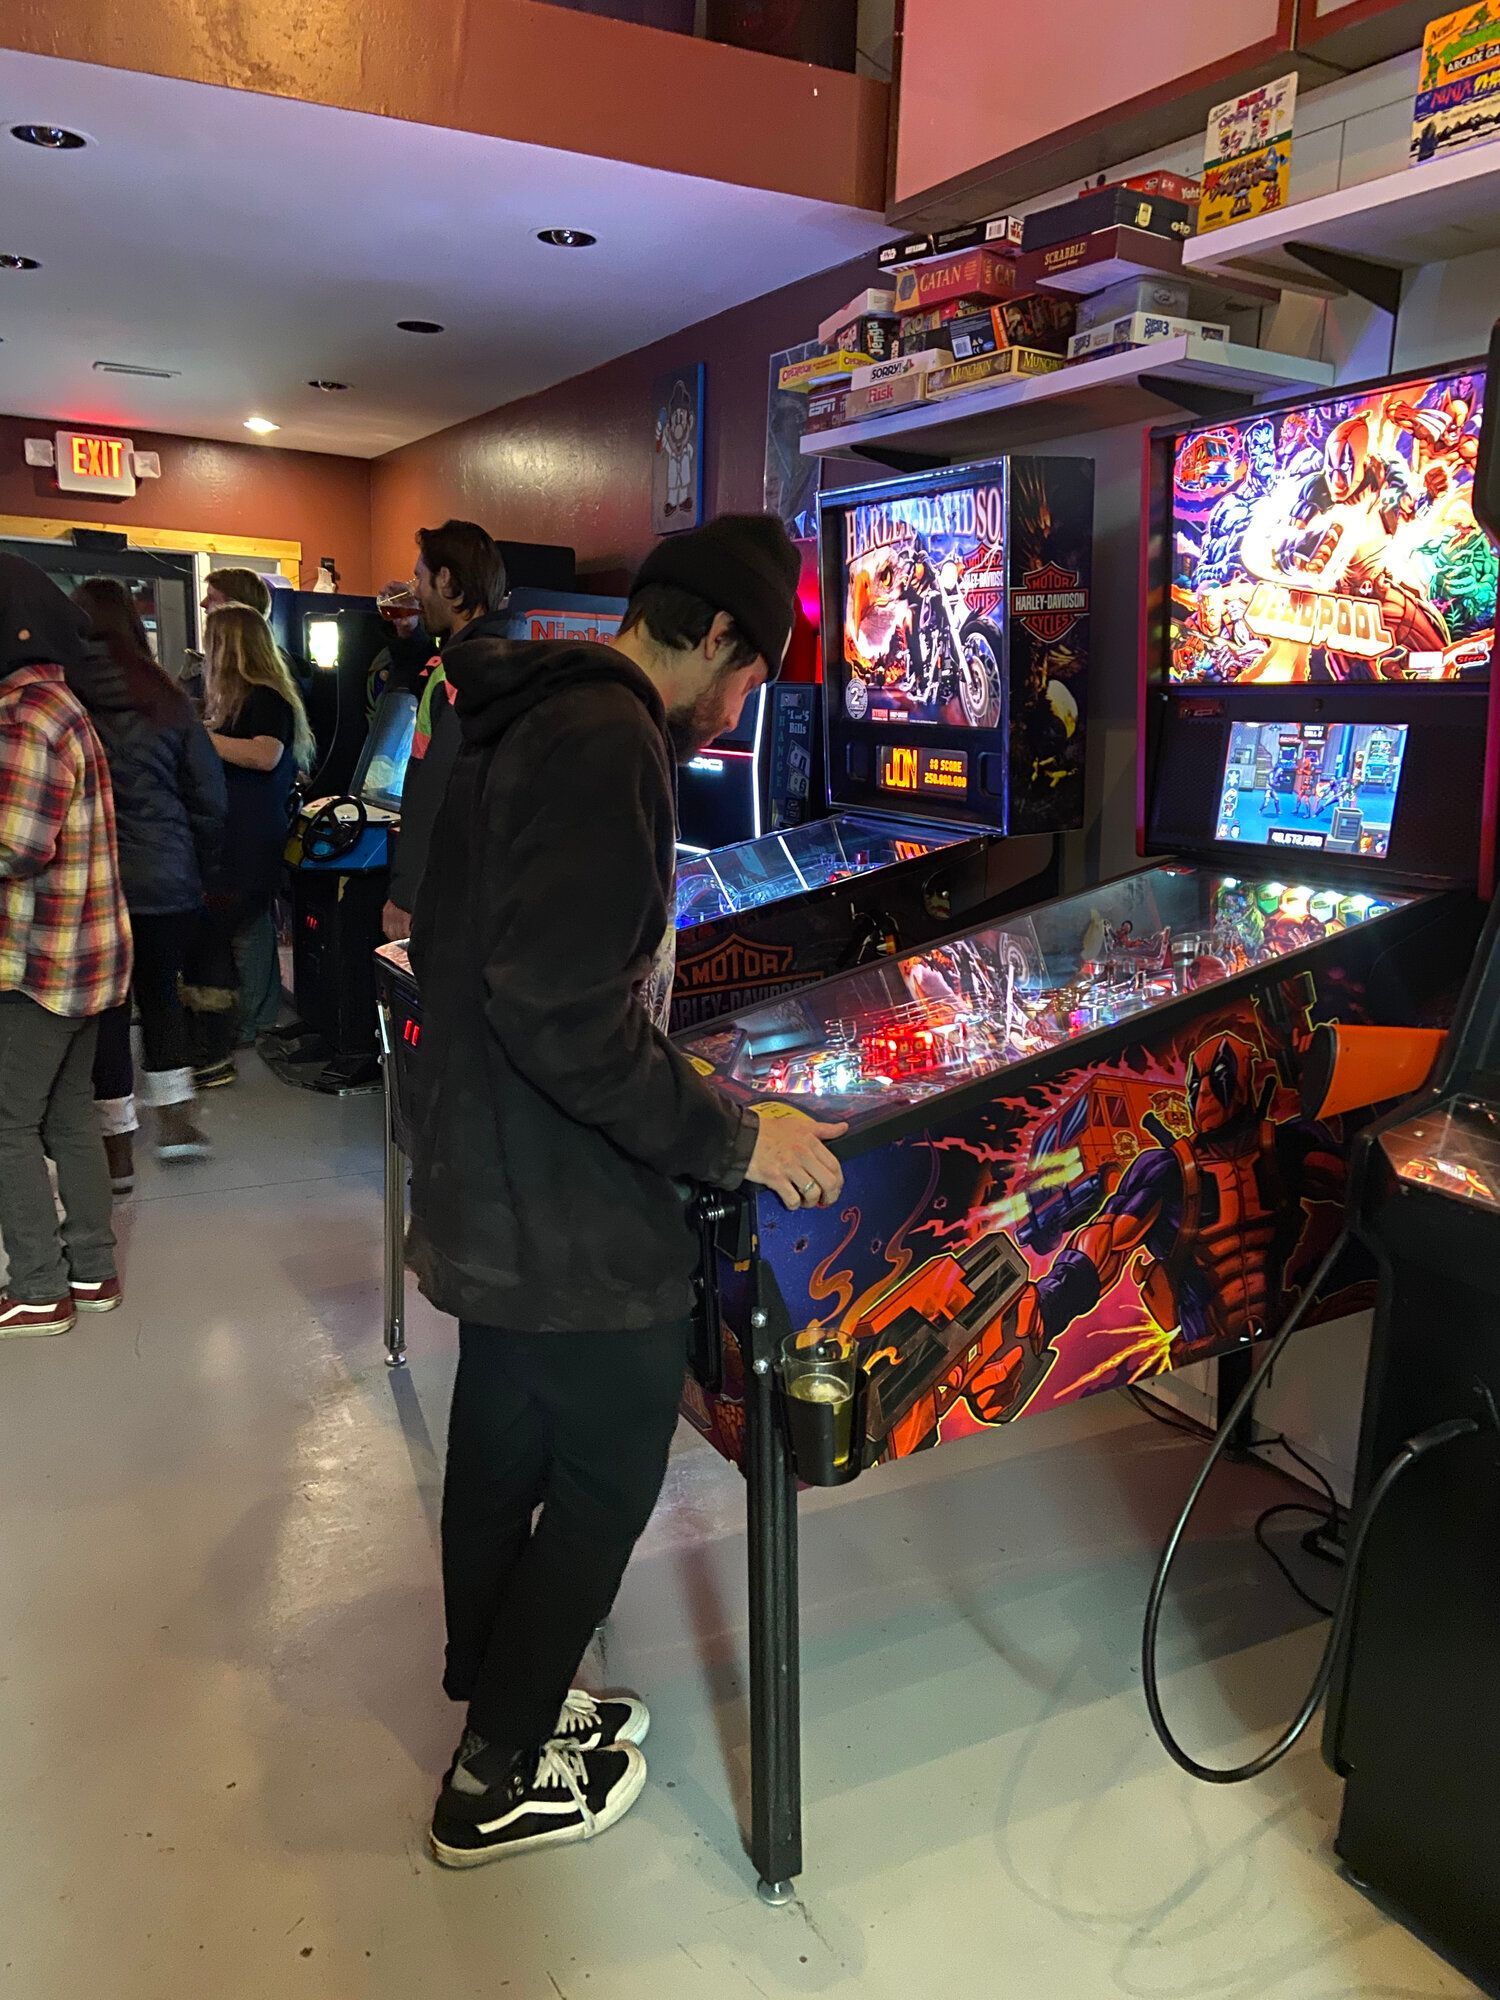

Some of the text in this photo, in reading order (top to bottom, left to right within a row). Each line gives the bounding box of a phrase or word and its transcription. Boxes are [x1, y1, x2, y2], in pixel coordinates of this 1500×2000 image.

[1447, 45, 1500, 73] ARCADE GA
[1181, 187, 1200, 200] Yaht
[1044, 242, 1087, 265] SCRABBLE
[920, 265, 961, 292] CATAN
[995, 264, 1017, 289] CAT
[867, 321, 885, 356] Jenga
[871, 362, 902, 380] SORRY!
[950, 358, 992, 382] MUNCHKIN
[868, 384, 894, 404] Risk
[808, 397, 836, 417] ESPN
[72, 436, 125, 479] EXIT
[845, 486, 1003, 566] HARLEY-DAVIDSO
[1032, 570, 1072, 589] MOTOR
[1015, 592, 1086, 611] HARLEY-DAVIDSON
[1031, 615, 1069, 638] CYCLES
[1246, 586, 1391, 646] DEADPOOL
[531, 620, 617, 645] Ninte
[1457, 653, 1485, 664] Stern
[789, 722, 807, 734] Bills
[886, 747, 918, 789] JON
[940, 759, 963, 773] SCORE
[692, 943, 779, 985] MOTOR
